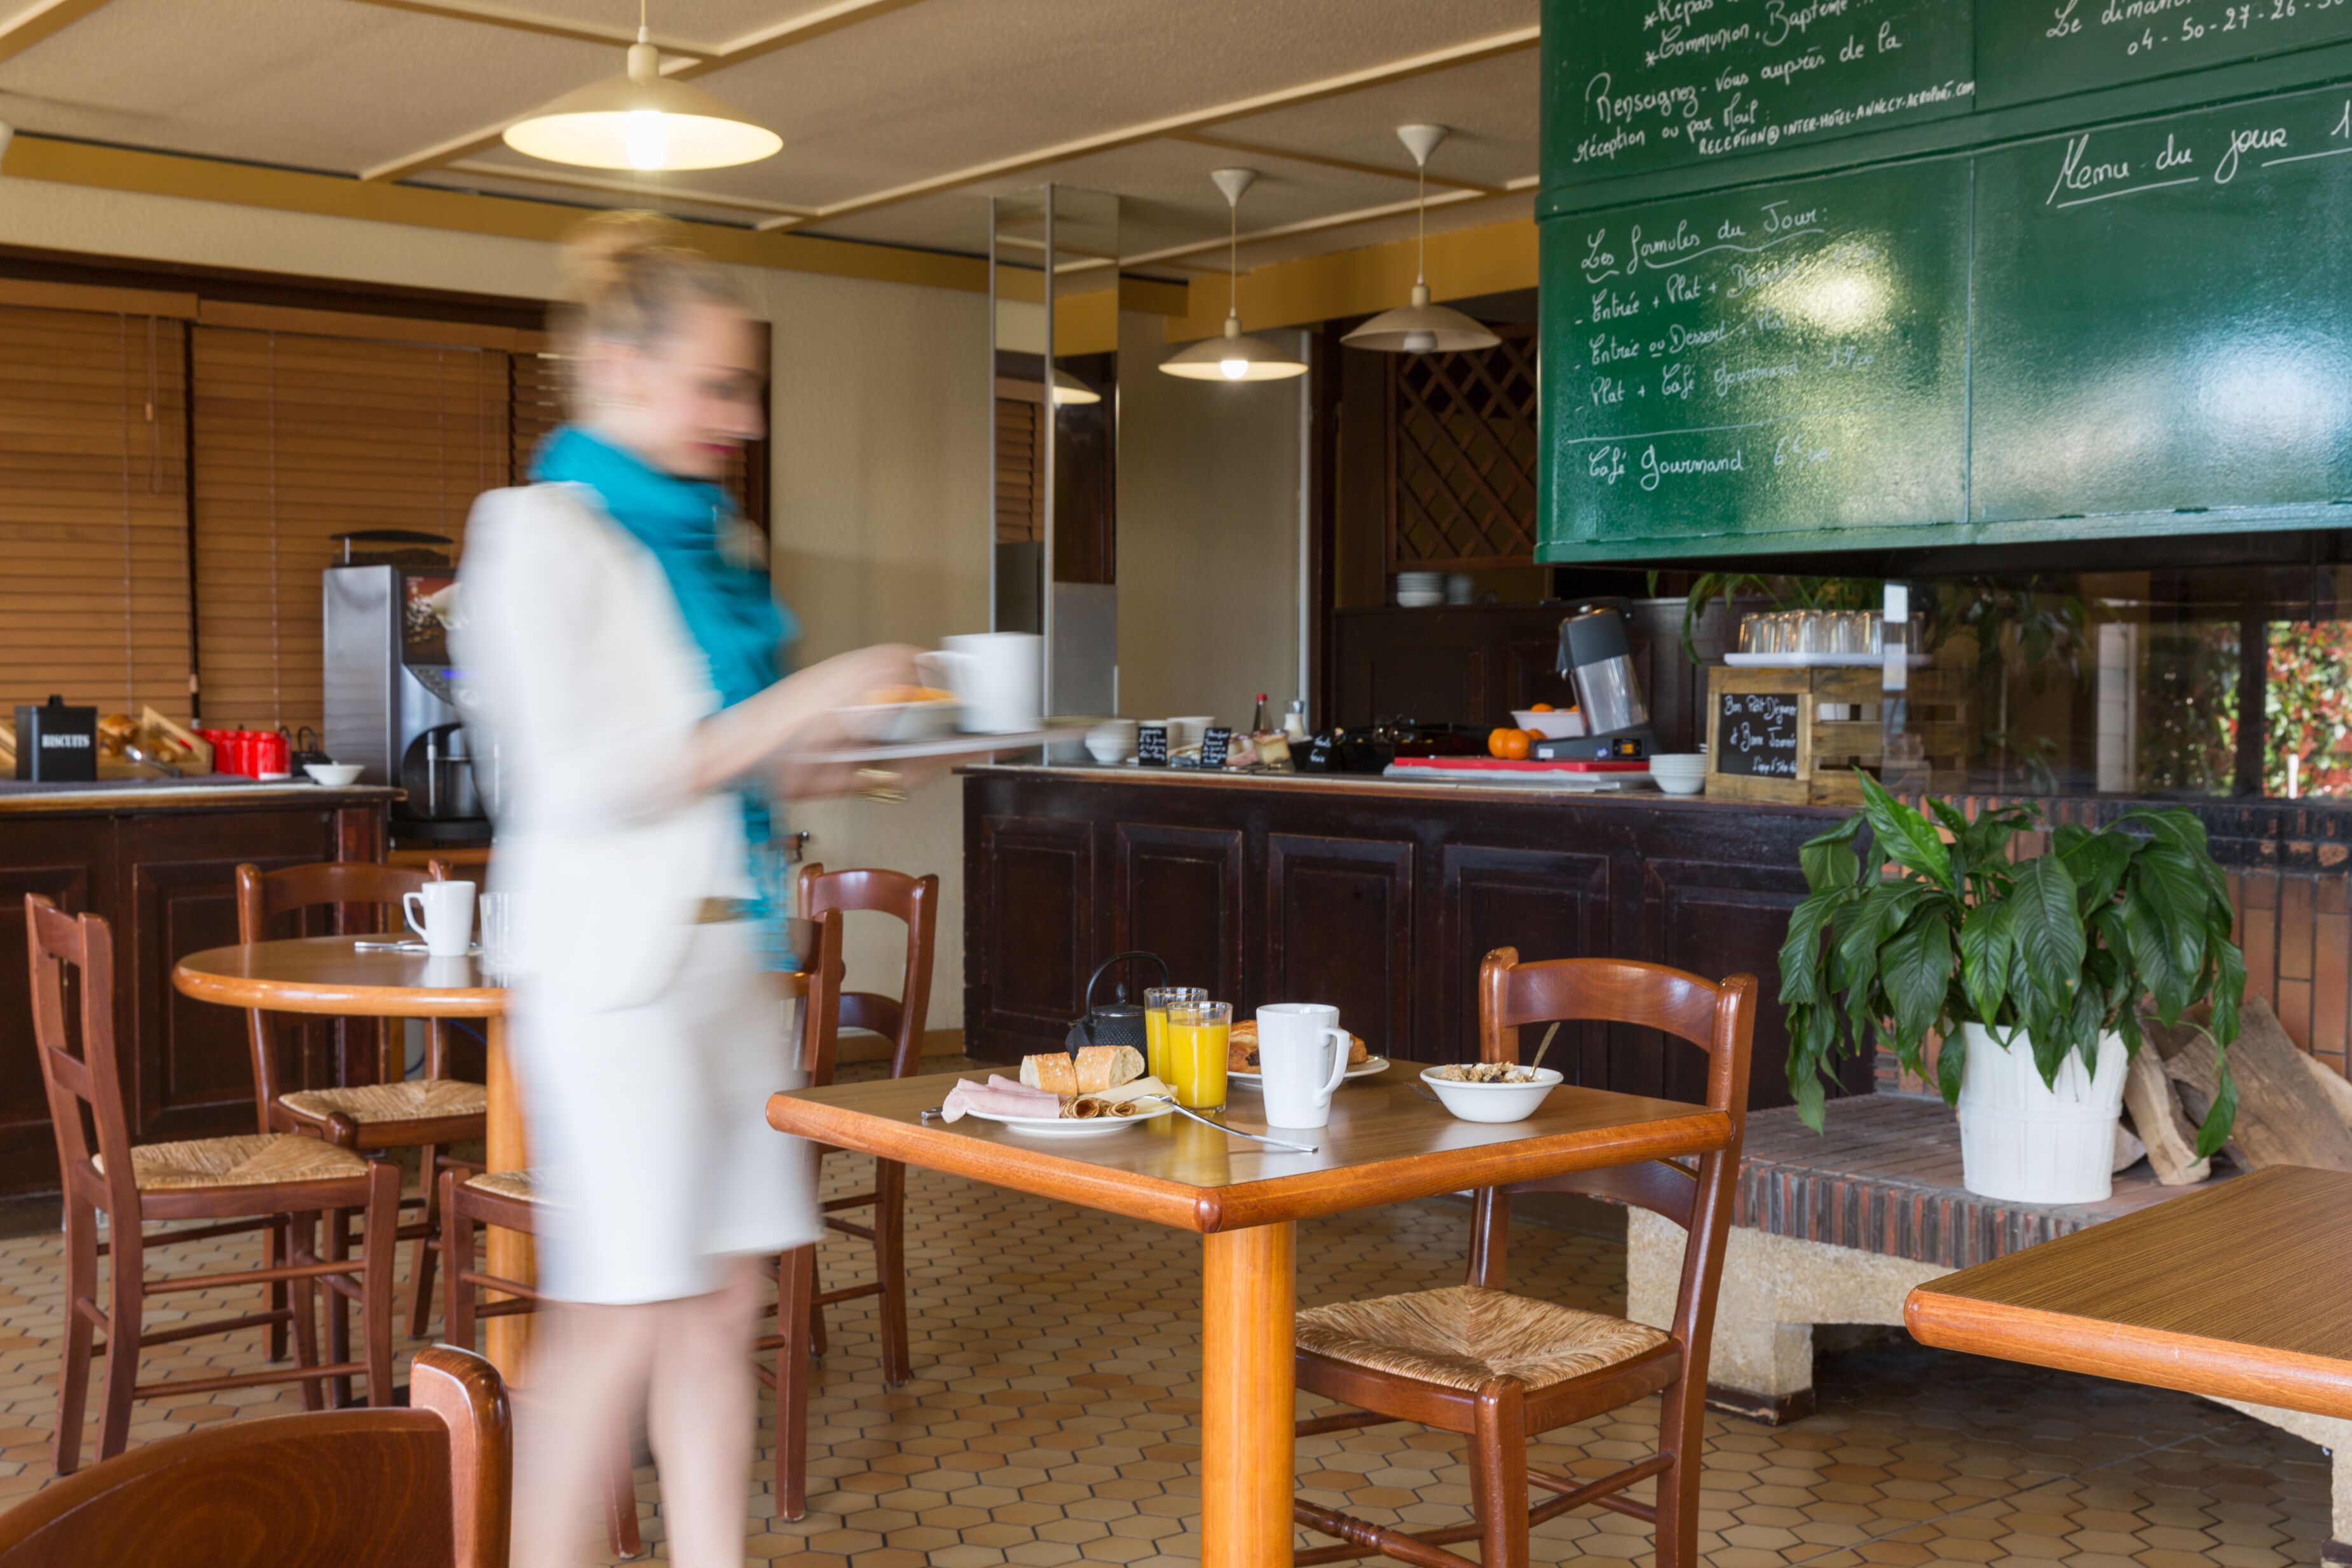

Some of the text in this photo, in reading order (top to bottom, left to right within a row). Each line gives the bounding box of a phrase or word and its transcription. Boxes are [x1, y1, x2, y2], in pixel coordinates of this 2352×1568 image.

[2046, 0, 2082, 37] Le
[1839, 34, 1865, 62] de
[1878, 20, 1903, 53] la
[1662, 126, 1679, 139] ou
[1687, 117, 1713, 143] par
[2046, 133, 2129, 205] Menu
[2156, 133, 2193, 171] du
[1581, 228, 1615, 269] Les
[1718, 220, 1745, 238] du
[1592, 289, 1640, 323] Entrée
[1666, 273, 1702, 303] Plat
[1589, 333, 1640, 366] Entrée
[1648, 340, 1665, 357] ou
[1669, 319, 1726, 354] Dessert
[1592, 376, 1624, 406] Plat
[1724, 694, 1742, 716] Bon
